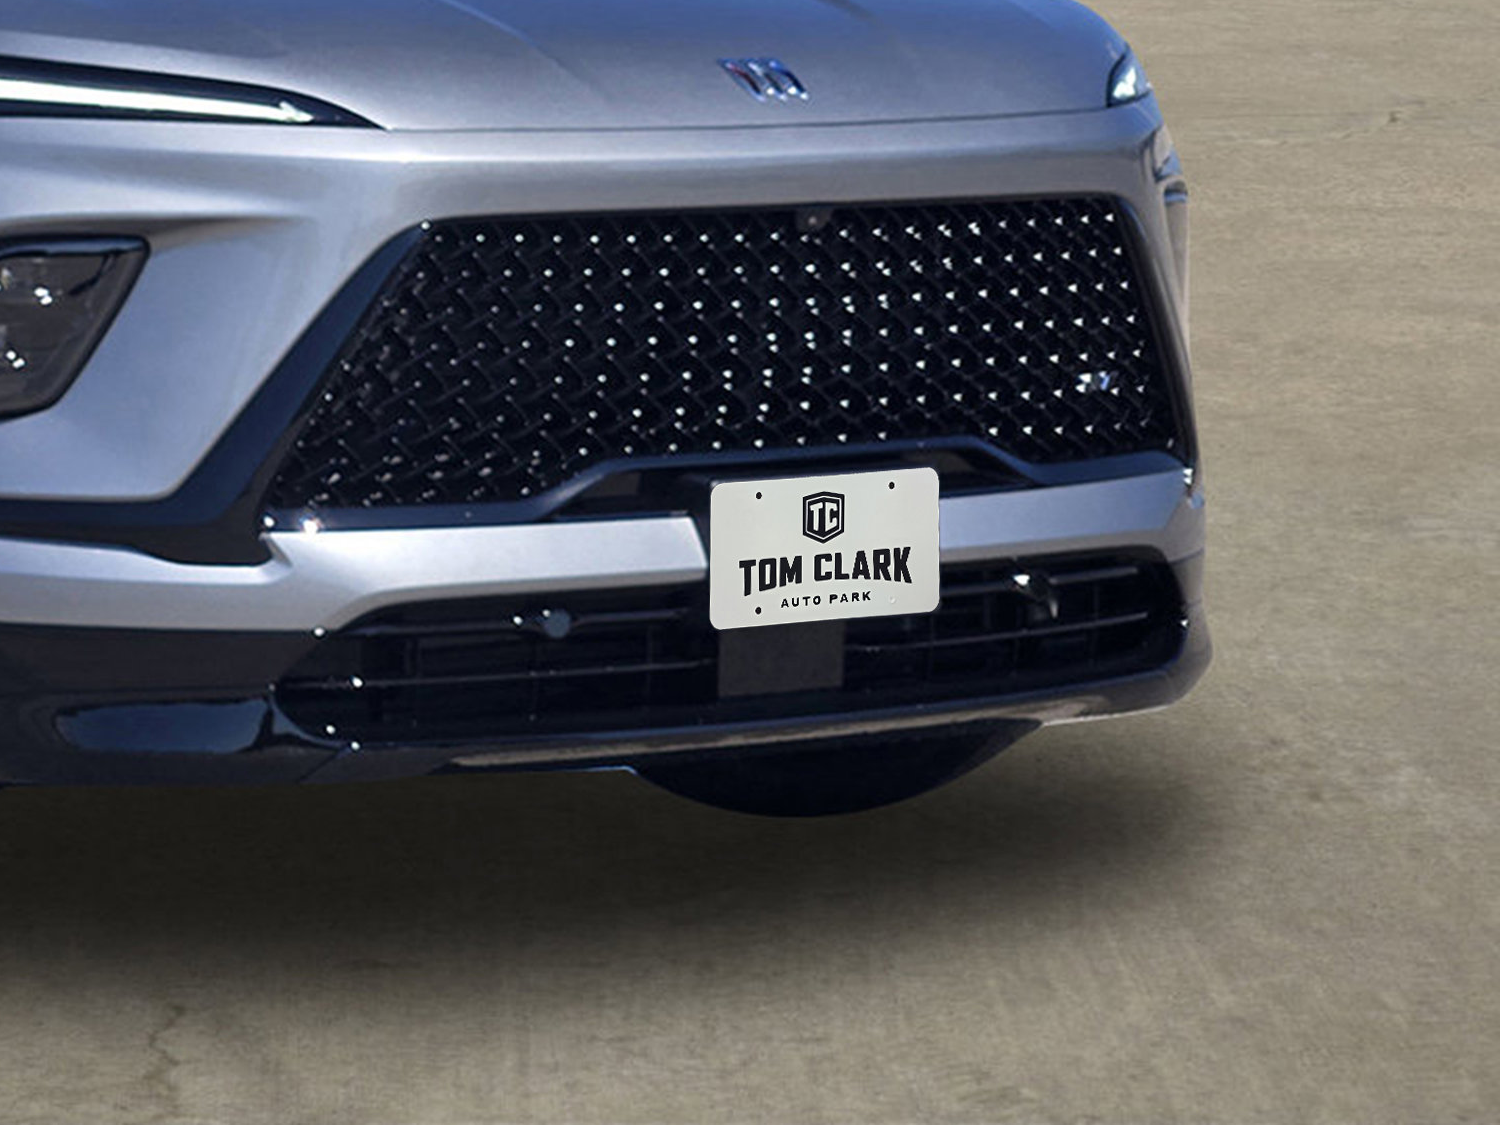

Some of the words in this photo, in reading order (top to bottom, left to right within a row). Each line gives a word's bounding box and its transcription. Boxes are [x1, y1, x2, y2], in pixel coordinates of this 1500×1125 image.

[809, 501, 838, 533] TC
[738, 555, 803, 597] TOM
[814, 546, 913, 584] CLARK
[780, 595, 822, 609] AUTO
[829, 590, 871, 604] PARK
